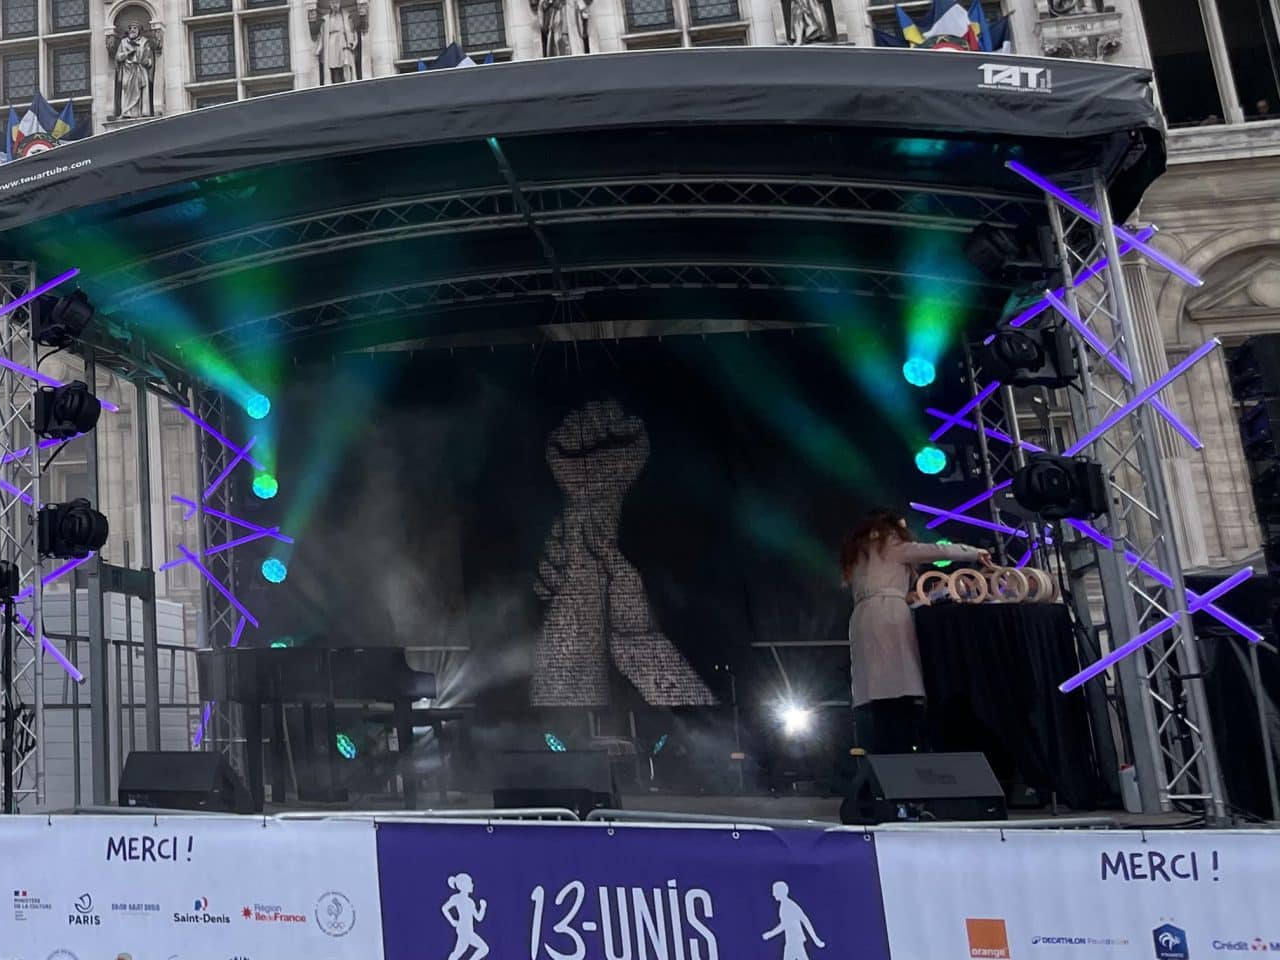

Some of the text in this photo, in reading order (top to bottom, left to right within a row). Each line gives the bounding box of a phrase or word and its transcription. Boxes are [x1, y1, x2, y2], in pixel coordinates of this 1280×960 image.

[106, 836, 177, 862] MERCI
[1101, 851, 1199, 882] MERCI
[68, 914, 101, 926] PARIS
[173, 912, 231, 924] Saint-Denis
[1041, 937, 1087, 945] DECATHLON
[971, 947, 1007, 957] orange
